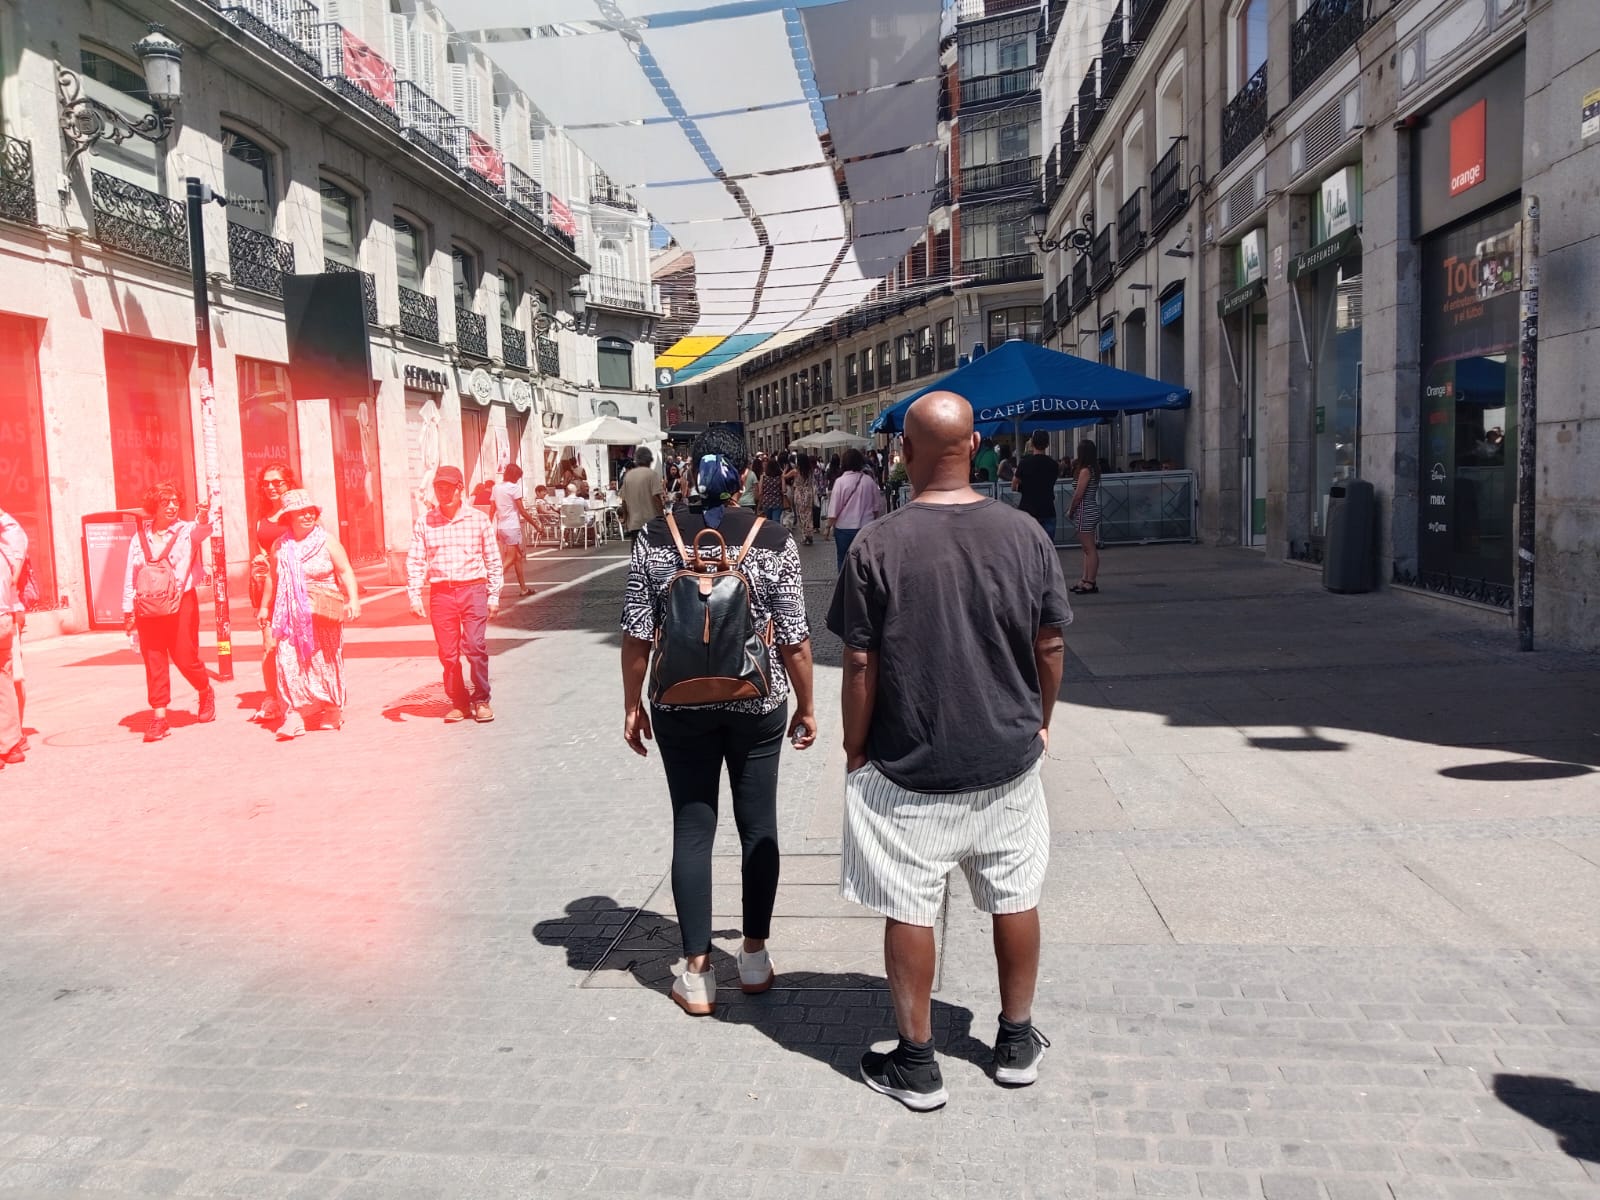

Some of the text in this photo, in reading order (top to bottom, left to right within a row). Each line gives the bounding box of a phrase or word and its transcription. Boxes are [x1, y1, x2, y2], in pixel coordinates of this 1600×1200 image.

[1451, 164, 1480, 190] orange
[404, 364, 449, 390] SEPHORA
[1426, 386, 1446, 397] Orange
[980, 398, 1100, 421] CAFÉ EUROPA
[116, 429, 178, 449] REBAJAS
[1430, 495, 1446, 505] max
